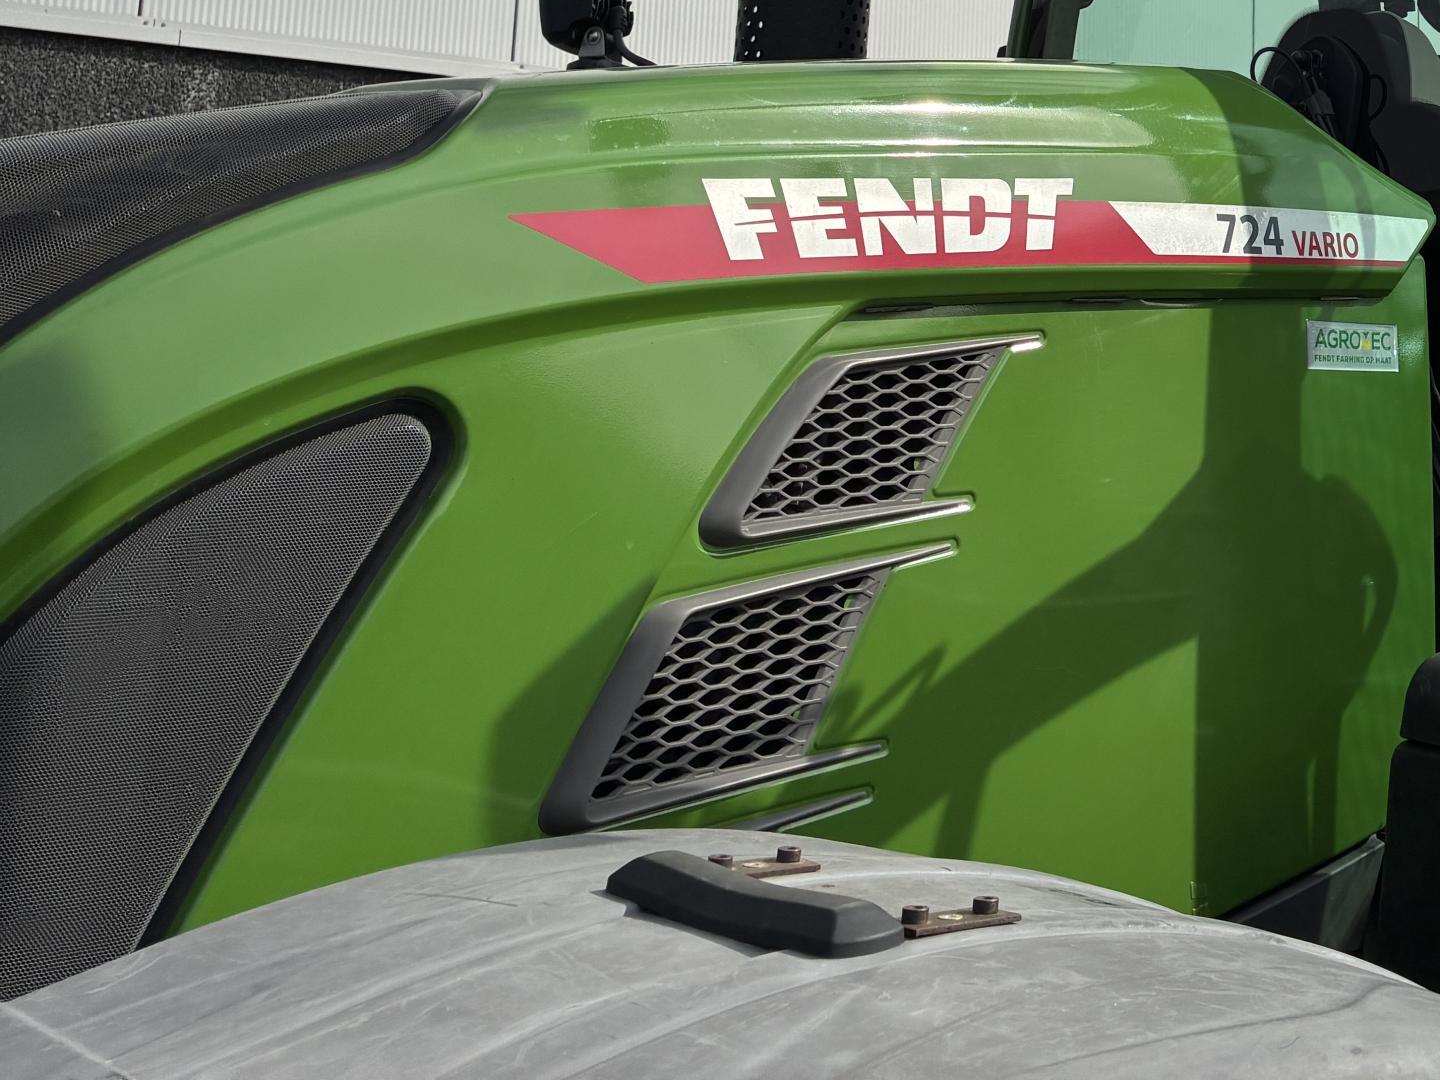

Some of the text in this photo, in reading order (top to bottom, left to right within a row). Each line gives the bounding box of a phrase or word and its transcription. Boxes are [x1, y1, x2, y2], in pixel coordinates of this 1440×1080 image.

[702, 177, 1074, 261] FENDT
[1216, 213, 1359, 258] 724 VARIO
[1314, 354, 1335, 363] FENDT
